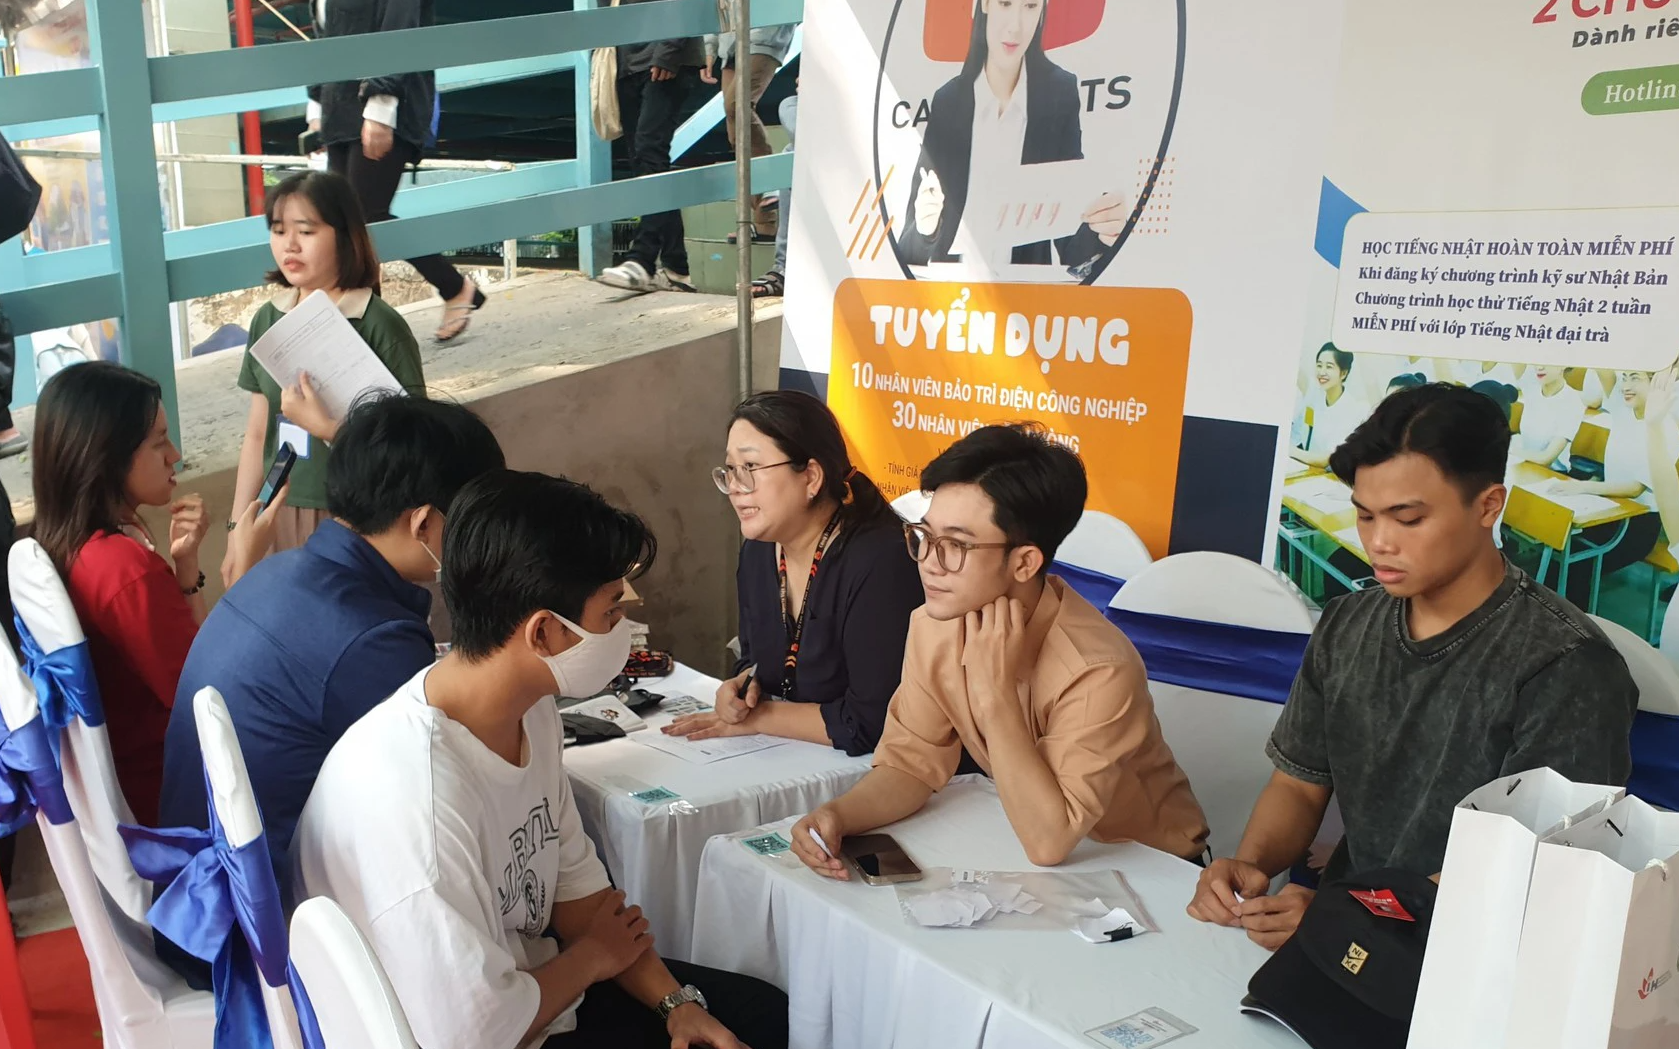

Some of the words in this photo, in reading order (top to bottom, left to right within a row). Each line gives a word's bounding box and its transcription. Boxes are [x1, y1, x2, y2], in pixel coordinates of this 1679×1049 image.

[1572, 24, 1636, 48] Dành
[1603, 79, 1679, 104] Hotlin
[1361, 241, 1392, 258] HỌC
[1394, 237, 1438, 255] TIẾNG
[1441, 238, 1484, 259] NHẬT
[1487, 238, 1534, 256] HOÀN
[1537, 238, 1584, 256] TOÀN
[1586, 235, 1636, 256] MIỄN
[1638, 236, 1675, 256] PHÍ
[1358, 266, 1382, 280] Khi
[1384, 266, 1418, 284] đăng
[1420, 266, 1438, 285] ký
[1441, 268, 1496, 286] chương
[1499, 268, 1538, 283] trình
[1541, 269, 1562, 288] kỹ
[1565, 271, 1587, 285] sư
[1588, 269, 1630, 289] Nhật
[1633, 268, 1668, 285] Bản
[1355, 291, 1406, 309] Chương
[1408, 292, 1444, 308] trình
[1447, 294, 1474, 312] học
[1477, 295, 1505, 310] thử
[1507, 295, 1551, 316] Tiếng
[1553, 297, 1594, 317] Nhật
[1597, 300, 1608, 313] 2
[1611, 297, 1651, 315] tuần
[869, 287, 996, 356] TUYỂN
[1004, 312, 1130, 374] DỤNG
[1351, 312, 1388, 331] MIỄN
[1390, 316, 1417, 332] PHÍ
[1419, 319, 1440, 334] với
[1442, 319, 1466, 338] lớp
[1470, 321, 1512, 341] Tiếng
[1514, 324, 1553, 343] Nhật
[1556, 326, 1582, 345] đại
[1585, 326, 1609, 343] trà
[851, 361, 874, 389] 10
[875, 371, 910, 395] NHÂN
[912, 375, 941, 398] VIÊN
[944, 377, 972, 402] BẢO
[974, 382, 997, 406] TRÌ
[999, 385, 1034, 412] ĐIỆN
[1036, 389, 1081, 415] CÔNG
[1084, 397, 1148, 426] NGHIỆP
[891, 400, 916, 430] 30
[918, 414, 955, 437] NHÂN
[958, 417, 990, 437] VIÊ
[887, 461, 905, 476] TÍNH
[906, 465, 918, 479] GIÁ
[898, 485, 913, 496] VIÊ
